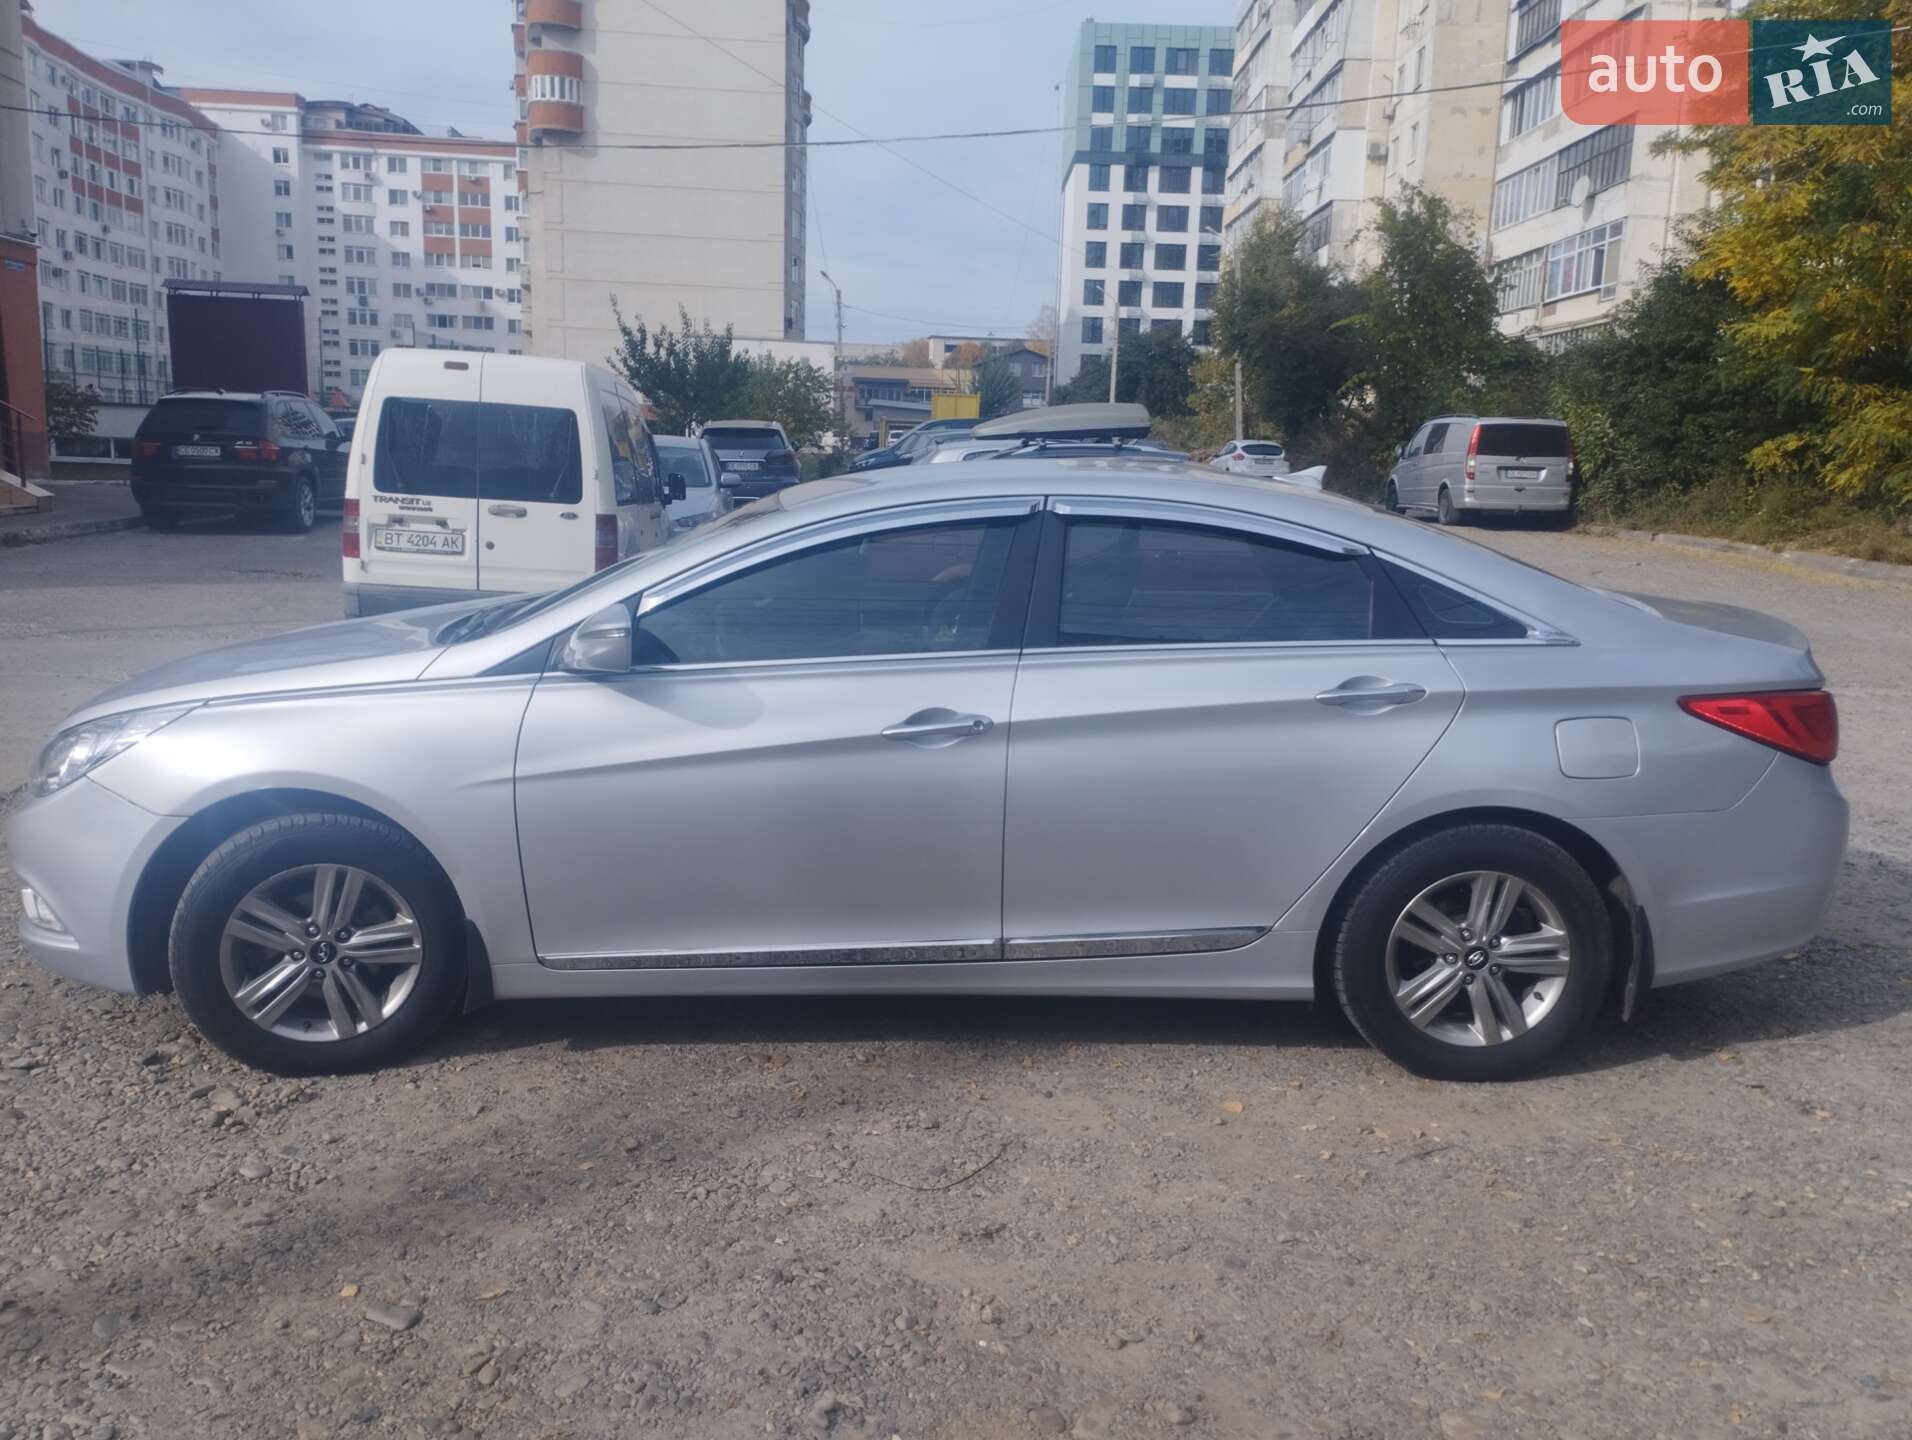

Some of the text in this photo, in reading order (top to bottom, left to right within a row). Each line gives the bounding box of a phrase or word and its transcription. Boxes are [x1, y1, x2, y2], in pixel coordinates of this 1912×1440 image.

[372, 495, 421, 506] TRANSIT
[385, 532, 459, 549] BT 4204 AK
